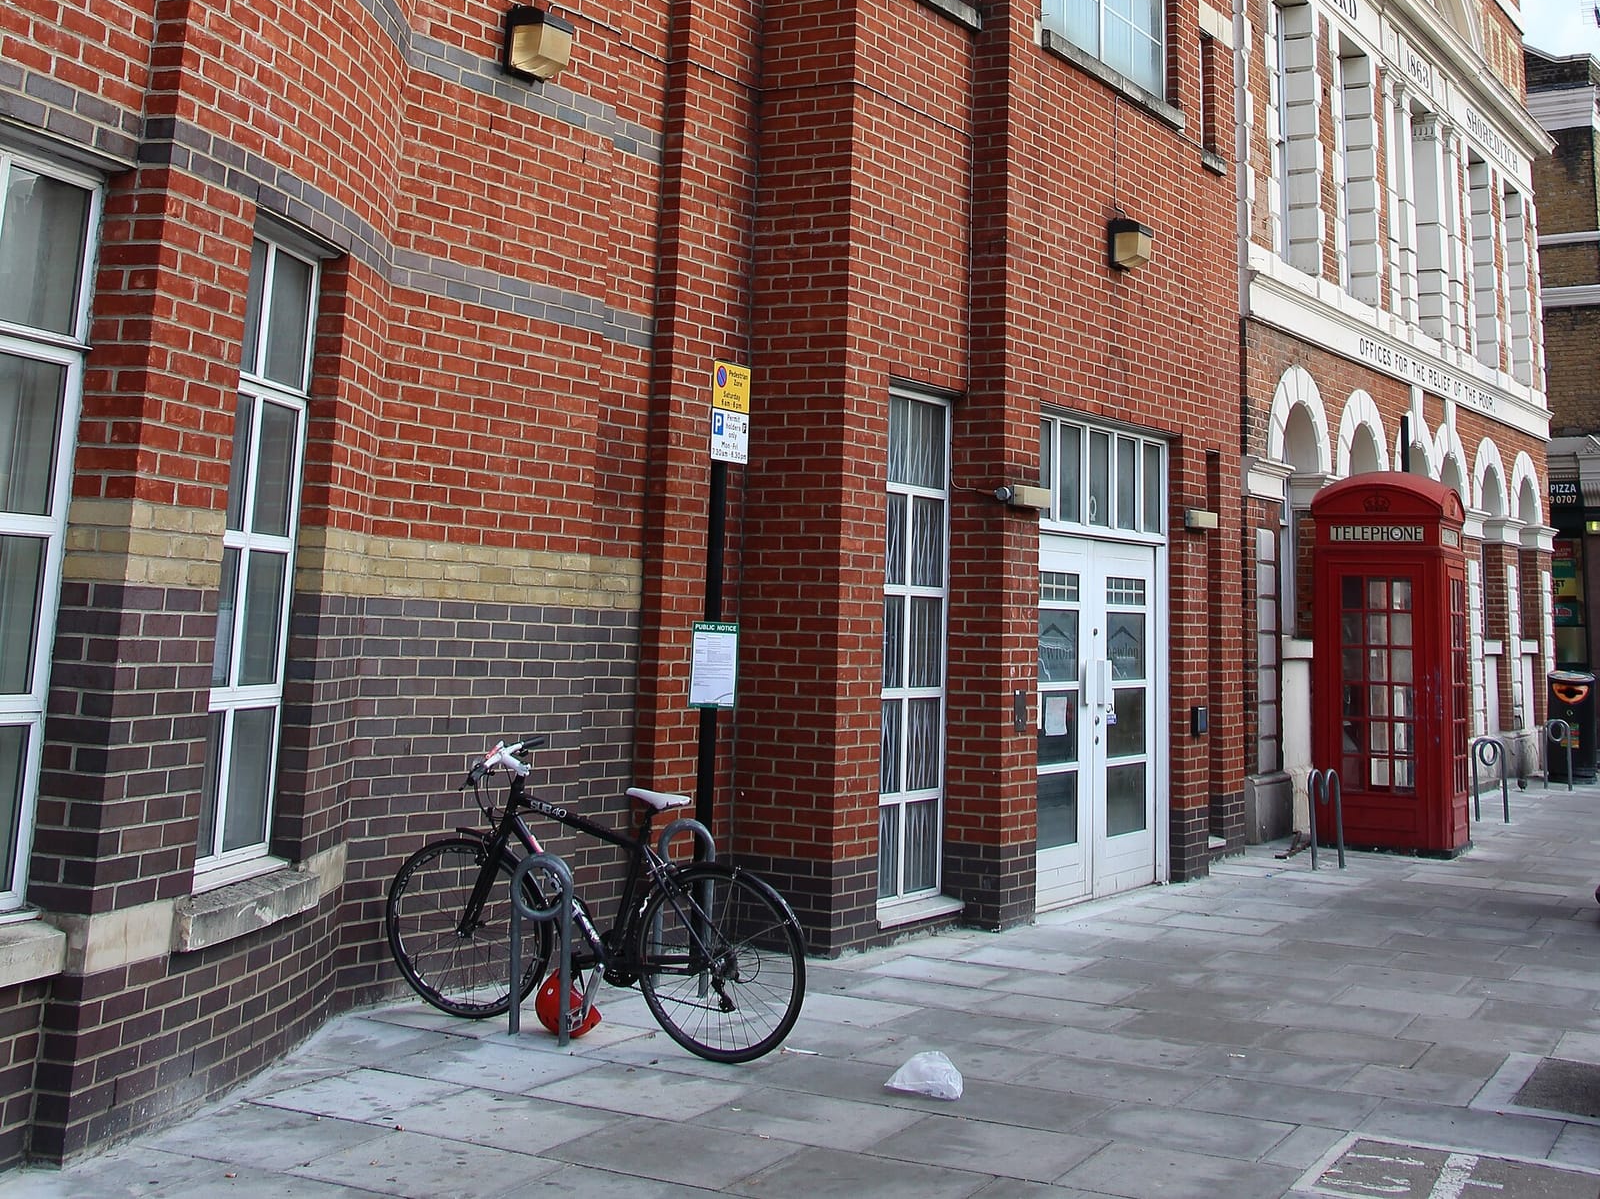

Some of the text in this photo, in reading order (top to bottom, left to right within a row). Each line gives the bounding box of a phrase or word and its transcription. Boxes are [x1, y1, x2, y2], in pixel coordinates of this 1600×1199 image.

[1406, 49, 1430, 90] 1863
[1466, 107, 1519, 174] SHOREDITCH
[729, 370, 748, 380] Pedestrian
[1359, 337, 1392, 367] OFFICES
[1394, 353, 1408, 374] FOR
[1411, 361, 1426, 383] THE
[1428, 368, 1451, 392] RELIEF
[1453, 380, 1462, 397] OF
[1464, 385, 1477, 405] THE
[733, 379, 743, 388] Zone
[723, 391, 740, 401] Saturday
[727, 414, 740, 422] Permit
[715, 414, 723, 434] P
[725, 423, 741, 431] holders
[1550, 483, 1577, 494] PIZZA
[1556, 495, 1577, 504] 0707
[1332, 526, 1423, 541] TELEPHONE
[695, 623, 716, 631] PUBLIC
